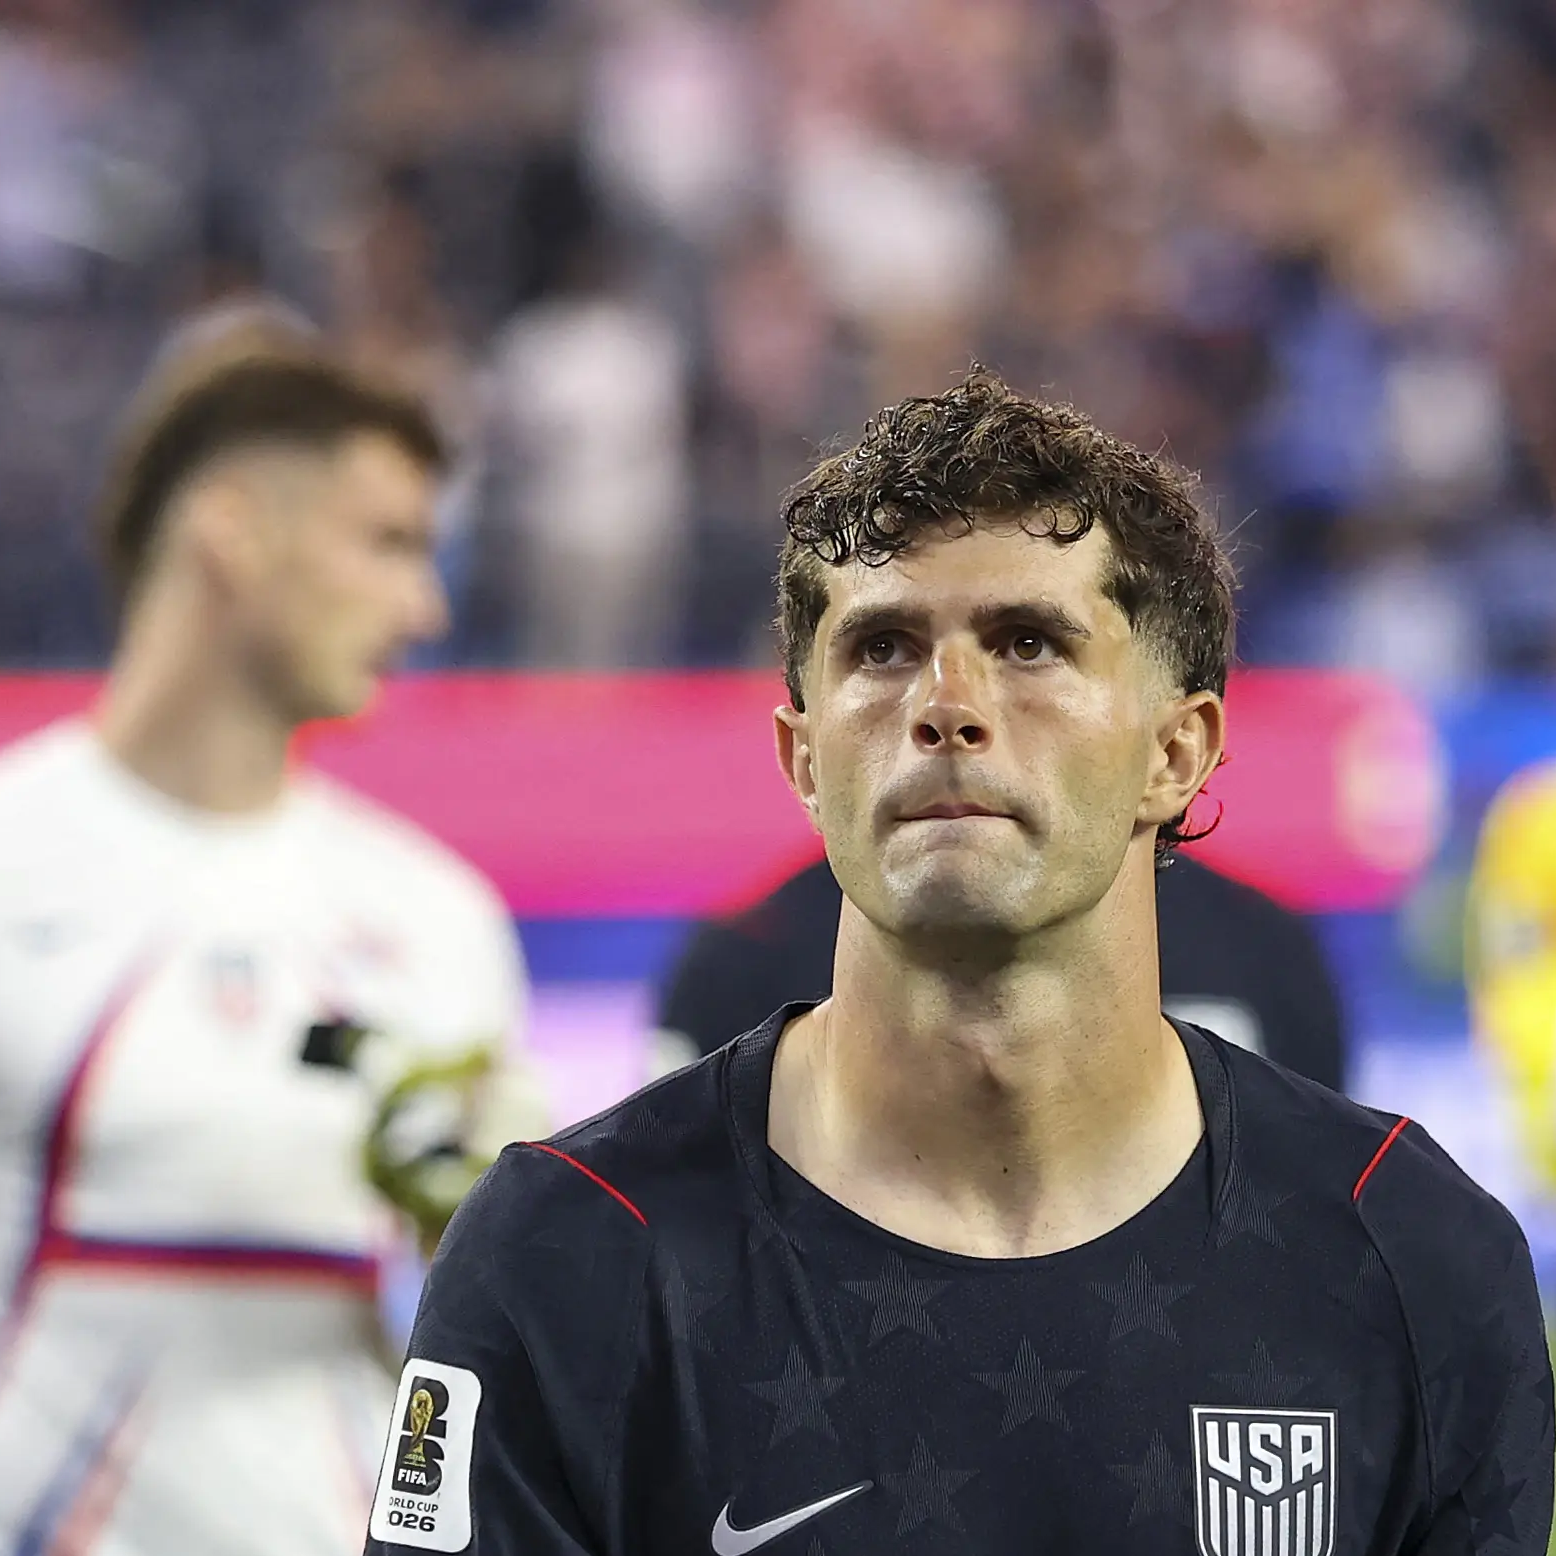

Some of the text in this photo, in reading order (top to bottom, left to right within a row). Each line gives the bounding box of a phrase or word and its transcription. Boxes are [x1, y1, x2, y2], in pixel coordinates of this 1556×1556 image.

[1205, 1420, 1323, 1496] USA
[397, 1468, 427, 1486] FIFA
[389, 1496, 439, 1513] ORLD CUP
[387, 1510, 436, 1533] 026
